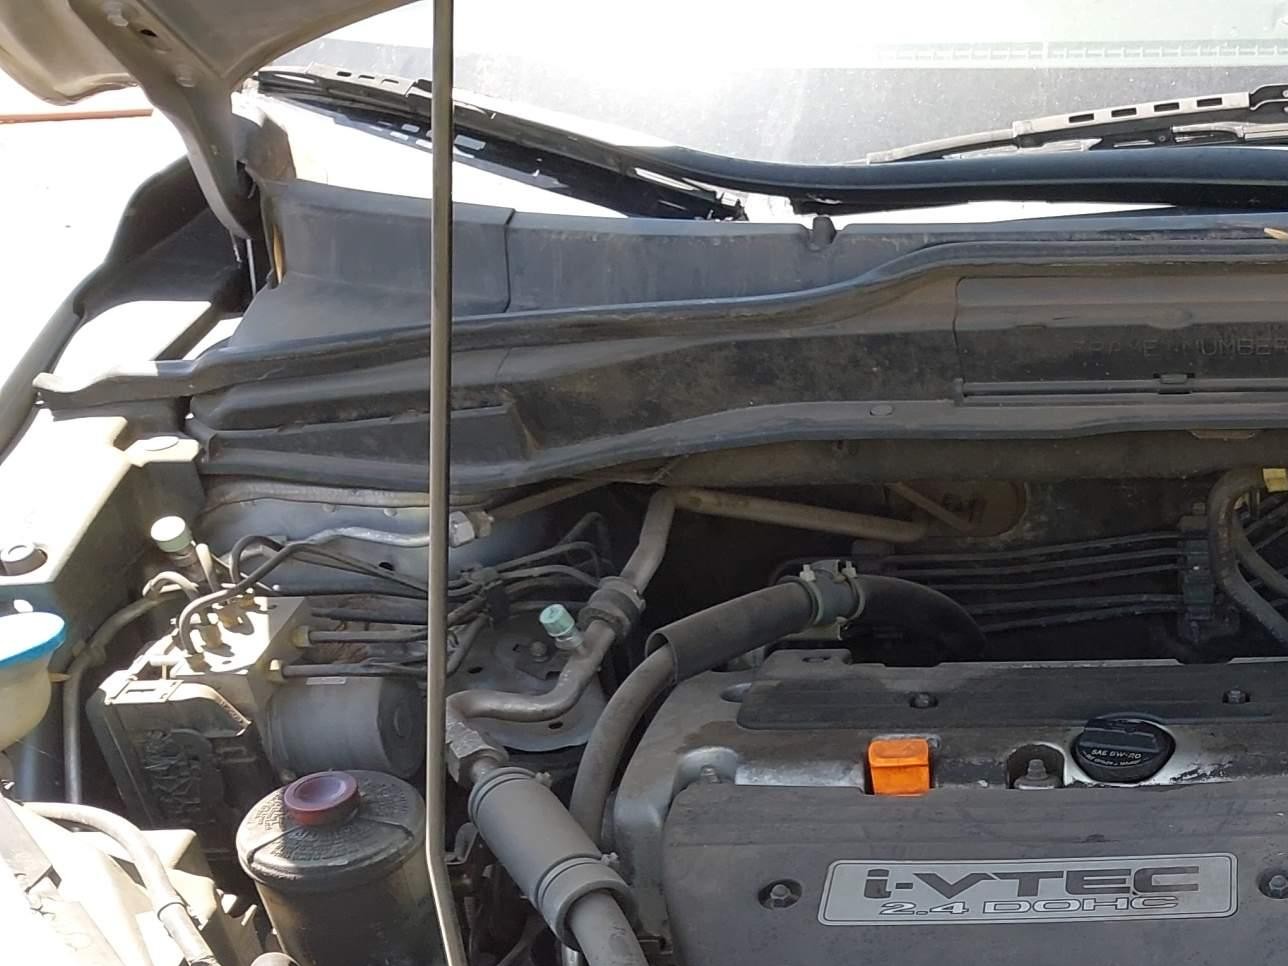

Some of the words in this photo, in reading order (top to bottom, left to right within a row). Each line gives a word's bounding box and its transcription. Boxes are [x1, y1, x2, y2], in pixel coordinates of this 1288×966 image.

[1091, 748, 1108, 757] SAE
[863, 866, 1200, 898] i-VTEC
[879, 899, 970, 916] 2.4
[982, 895, 1178, 914] DOHC
